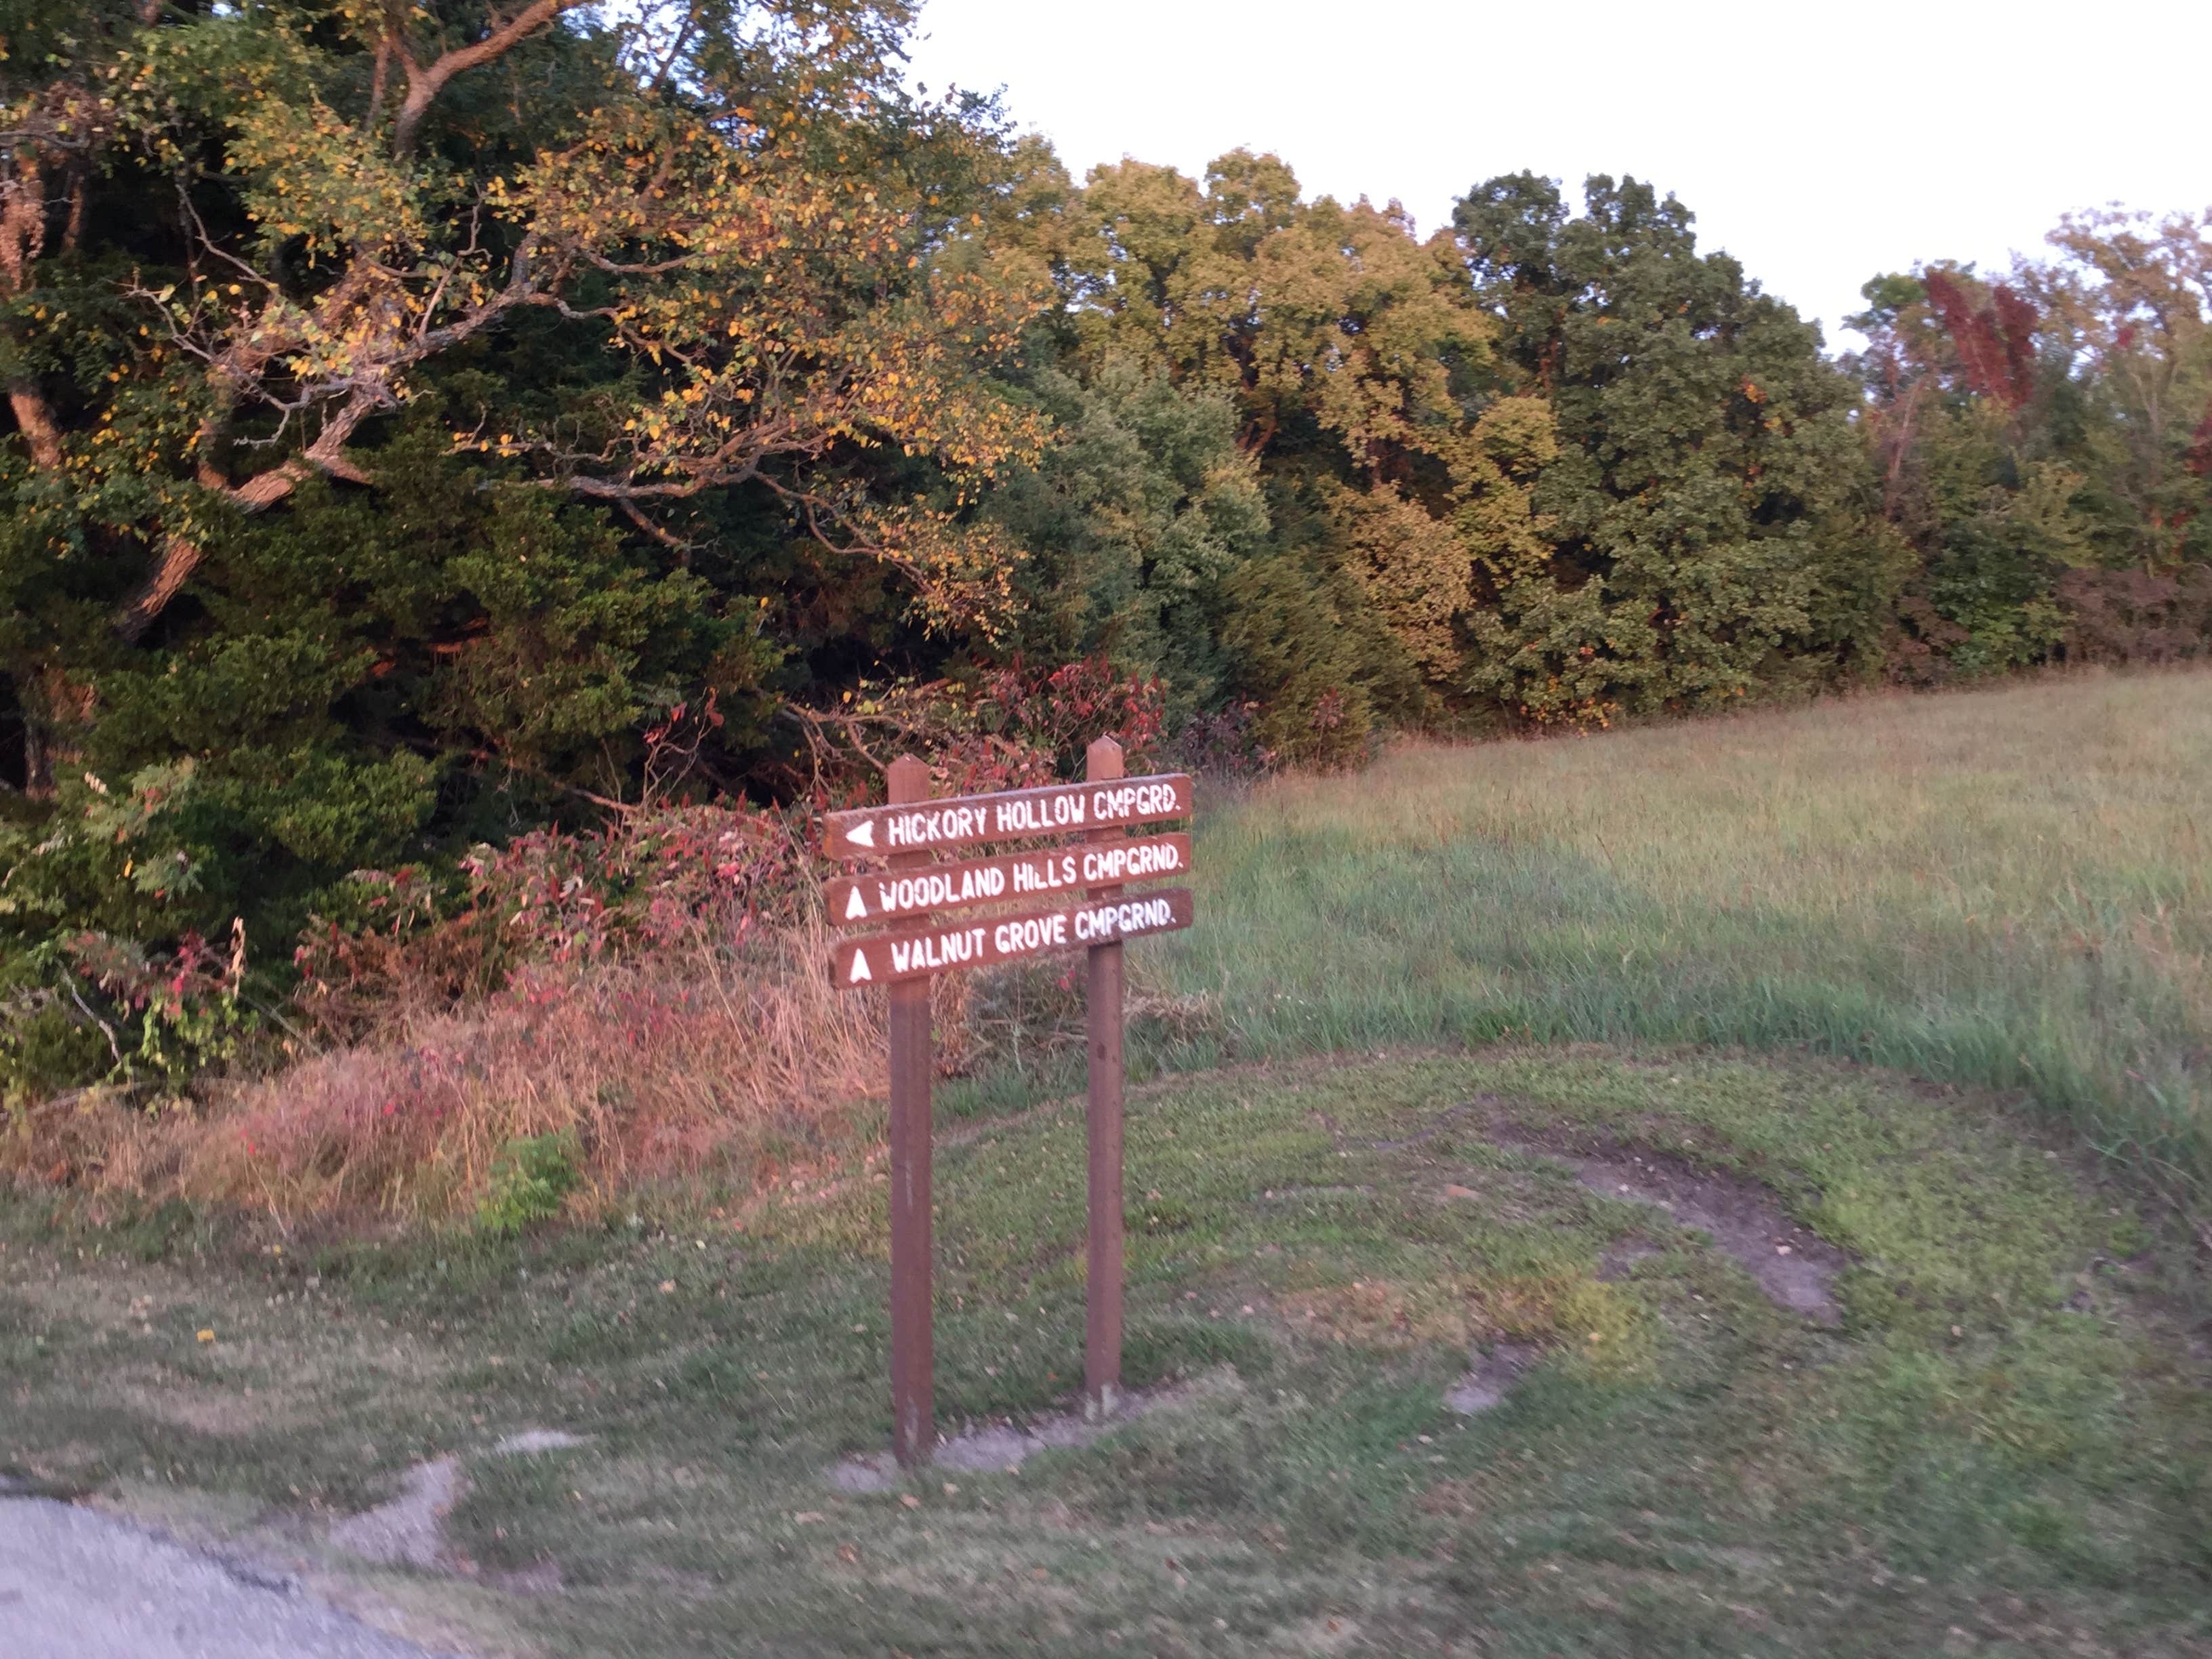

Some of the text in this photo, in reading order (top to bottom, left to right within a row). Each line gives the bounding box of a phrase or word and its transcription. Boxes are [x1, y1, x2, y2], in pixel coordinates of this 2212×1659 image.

[888, 783, 1181, 846] HICKORY HOLLOW CMPGRD.
[879, 843, 1185, 913] WOODLAND HILLS CMPGRND.
[890, 898, 1177, 973] WALNUT GROVE CMPGRND.
